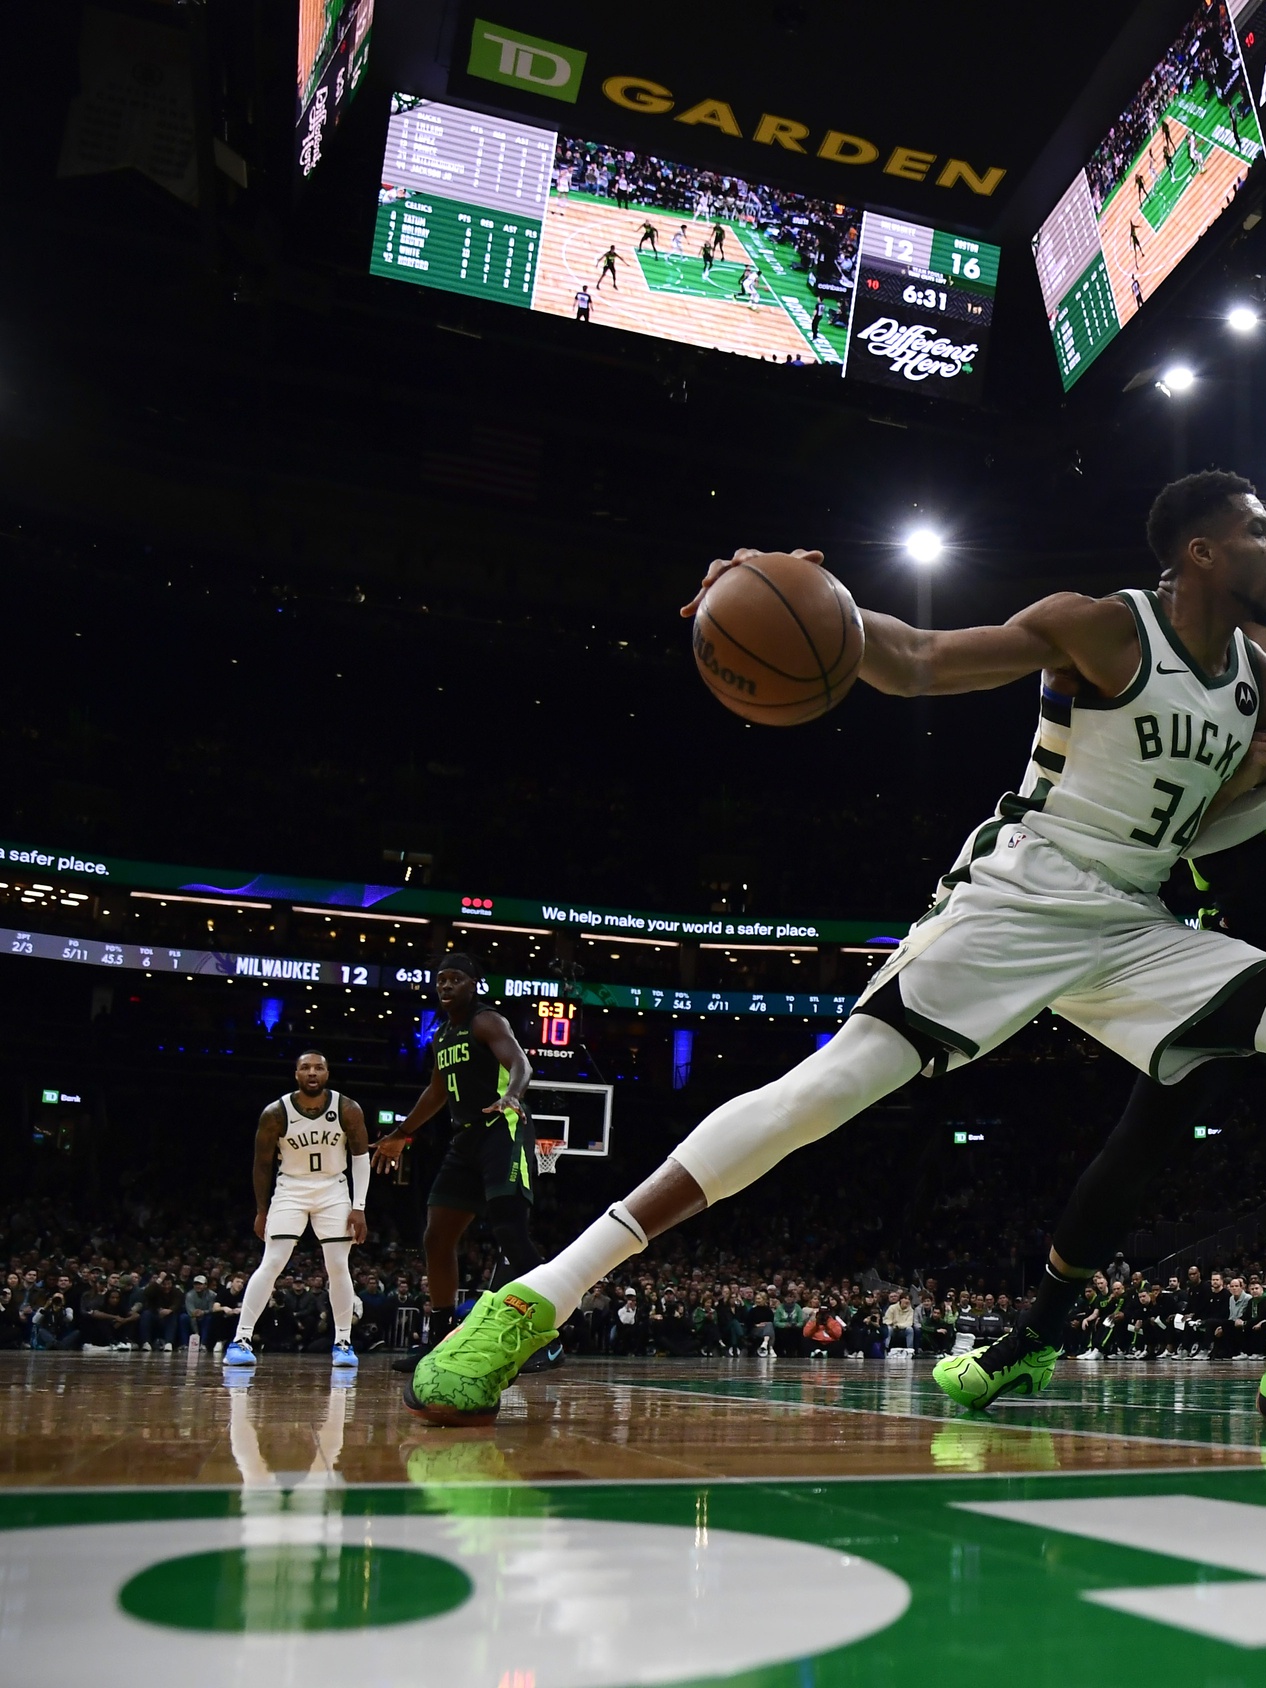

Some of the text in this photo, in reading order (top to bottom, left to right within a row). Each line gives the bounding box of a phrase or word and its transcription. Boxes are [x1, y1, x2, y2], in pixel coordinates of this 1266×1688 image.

[483, 32, 1007, 196] TD GARDEN
[405, 200, 432, 214] CELTICS
[458, 213, 471, 224] PTS
[503, 224, 517, 234] AST
[525, 229, 537, 239] FLS
[884, 235, 914, 263] 12
[951, 252, 981, 280] 16
[817, 283, 848, 293] coinbase
[866, 279, 880, 290] 10
[903, 285, 947, 311] 6:31
[967, 302, 983, 316] 1st
[857, 317, 979, 362] Different
[868, 342, 962, 381] Here
[1135, 714, 1243, 783] BUCK
[1130, 778, 1207, 856] 34
[9, 850, 55, 866] safer
[57, 856, 110, 876] place.
[542, 905, 819, 938] We help make your world a safer place.
[12, 941, 179, 969] 2/3 5/11 45.5 6 1
[236, 956, 559, 997] MILWAUKEE 12 6:31 BOSTON
[538, 1001, 577, 1019] 6:31
[654, 998, 662, 1008] 7
[673, 1001, 691, 1010] 54.5
[707, 1001, 729, 1011] 6/11
[749, 1002, 766, 1012] 4/8
[789, 1003, 794, 1013] 1
[813, 1003, 818, 1013] 1
[836, 1004, 843, 1014] 5
[541, 1017, 570, 1046] 10
[538, 1046, 574, 1058] TISSOT
[447, 1072, 461, 1102] 4
[287, 1131, 341, 1150] BUCKS
[309, 1153, 321, 1172] 0
